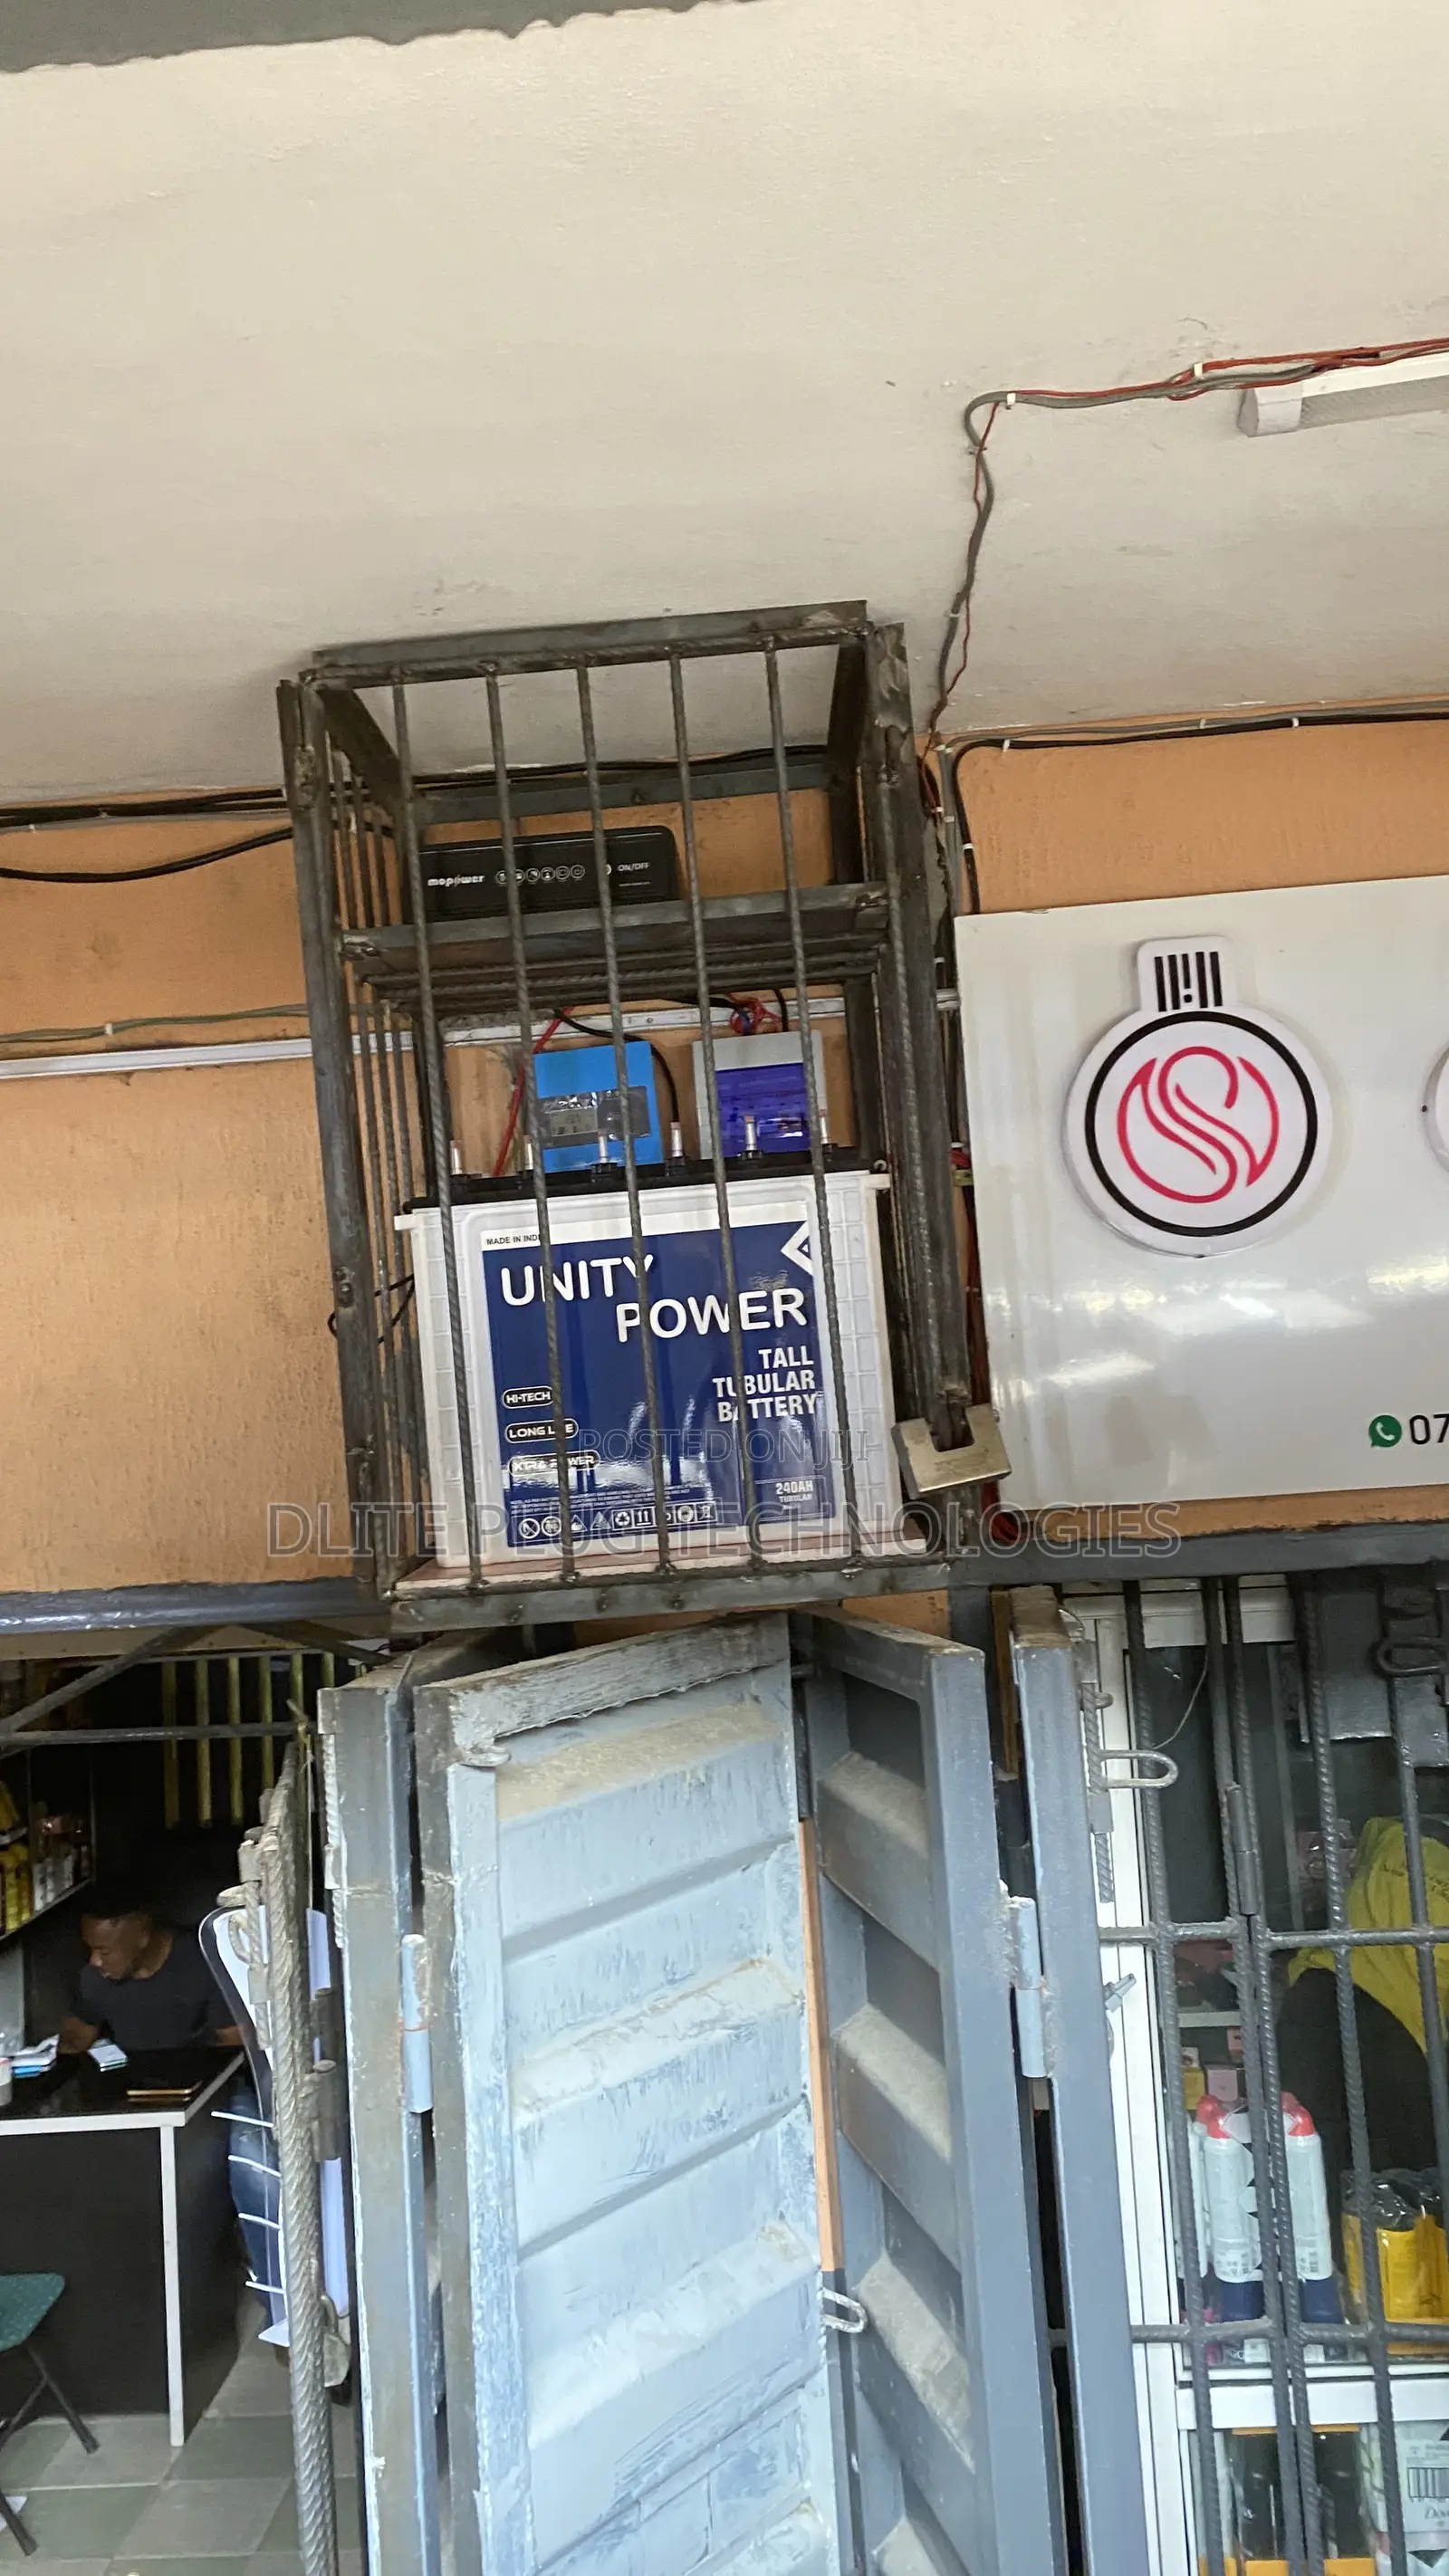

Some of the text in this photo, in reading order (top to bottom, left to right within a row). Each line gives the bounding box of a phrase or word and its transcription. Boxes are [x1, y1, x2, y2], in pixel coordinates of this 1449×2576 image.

[617, 862, 651, 871] ON/OFF
[486, 1236, 511, 1245] MADE
[501, 1254, 654, 1306] UNITY
[616, 1288, 808, 1343] POWER
[758, 1345, 814, 1369] TALL
[506, 1391, 552, 1403] HI-TECH
[509, 1423, 574, 1439] LONG LE
[776, 1480, 814, 1495] 240AH
